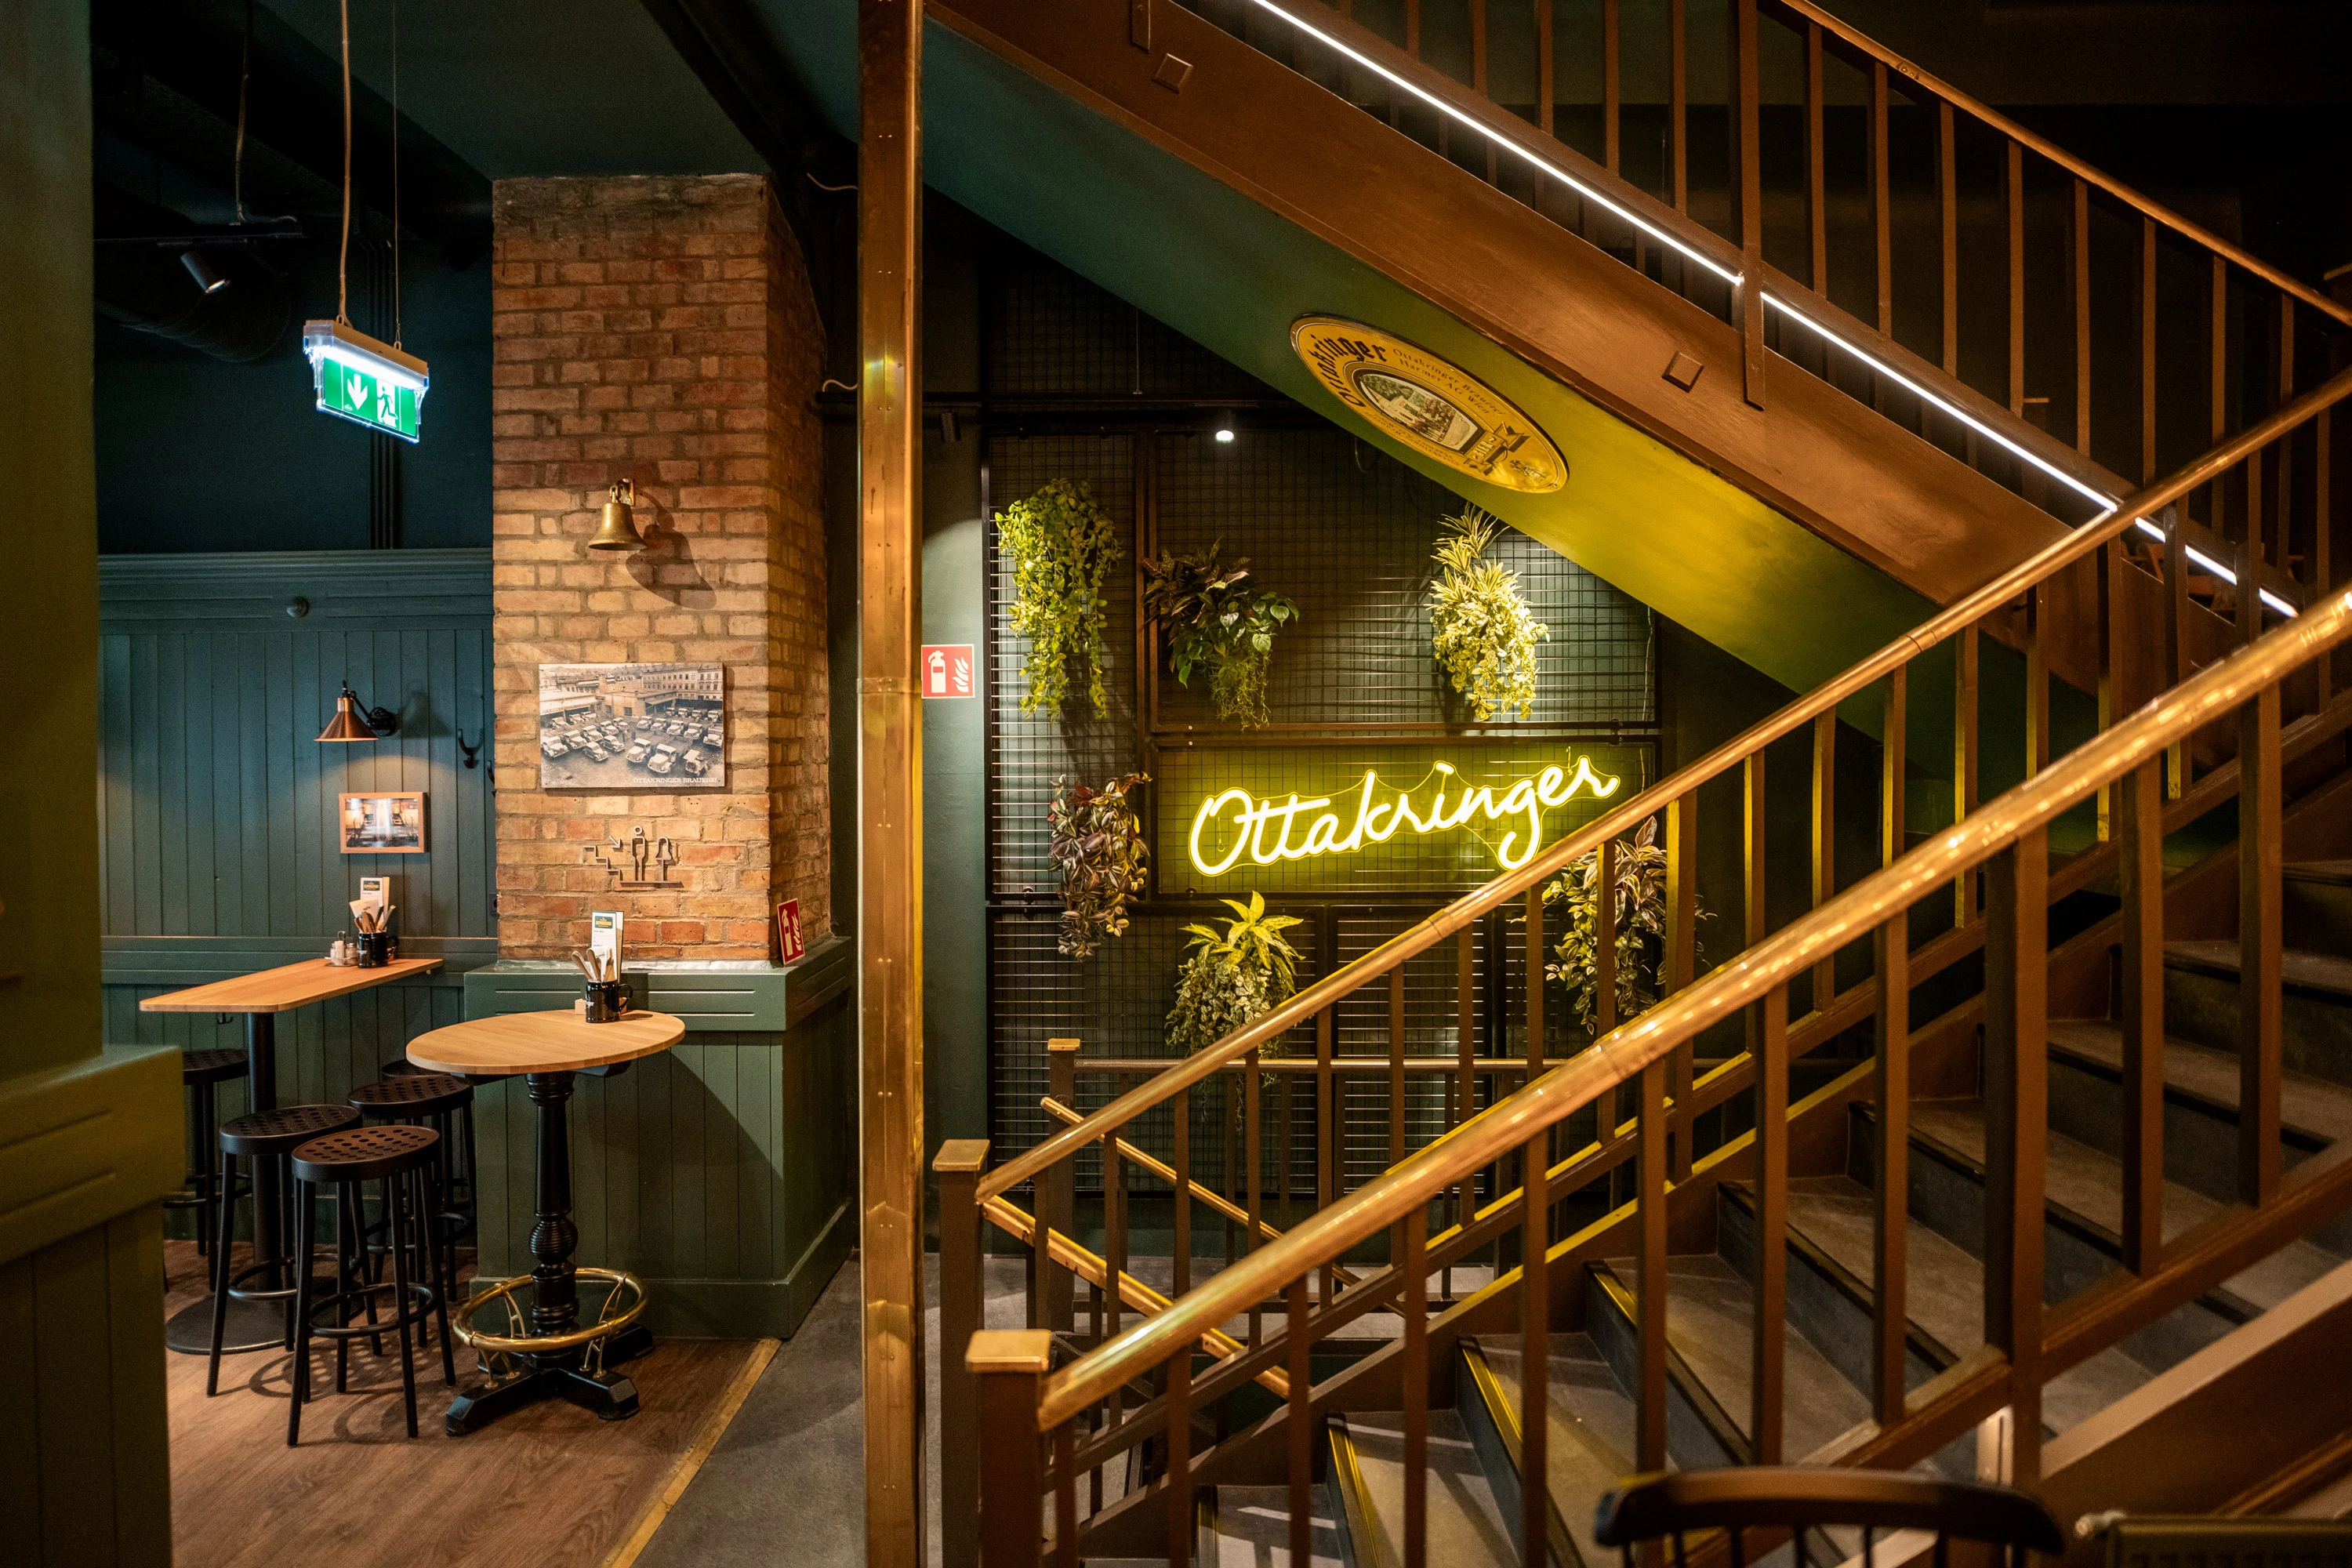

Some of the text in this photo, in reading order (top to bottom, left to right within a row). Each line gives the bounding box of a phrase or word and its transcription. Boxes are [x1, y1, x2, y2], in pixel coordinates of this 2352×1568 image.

[1307, 334, 1387, 408] Ottakringer
[1393, 348, 1504, 416] Ottakringer Brauerei
[1399, 359, 1490, 413] Harmer AG Wien
[1472, 441, 1493, 456] BIER
[1190, 757, 1620, 874] Ottakringer
